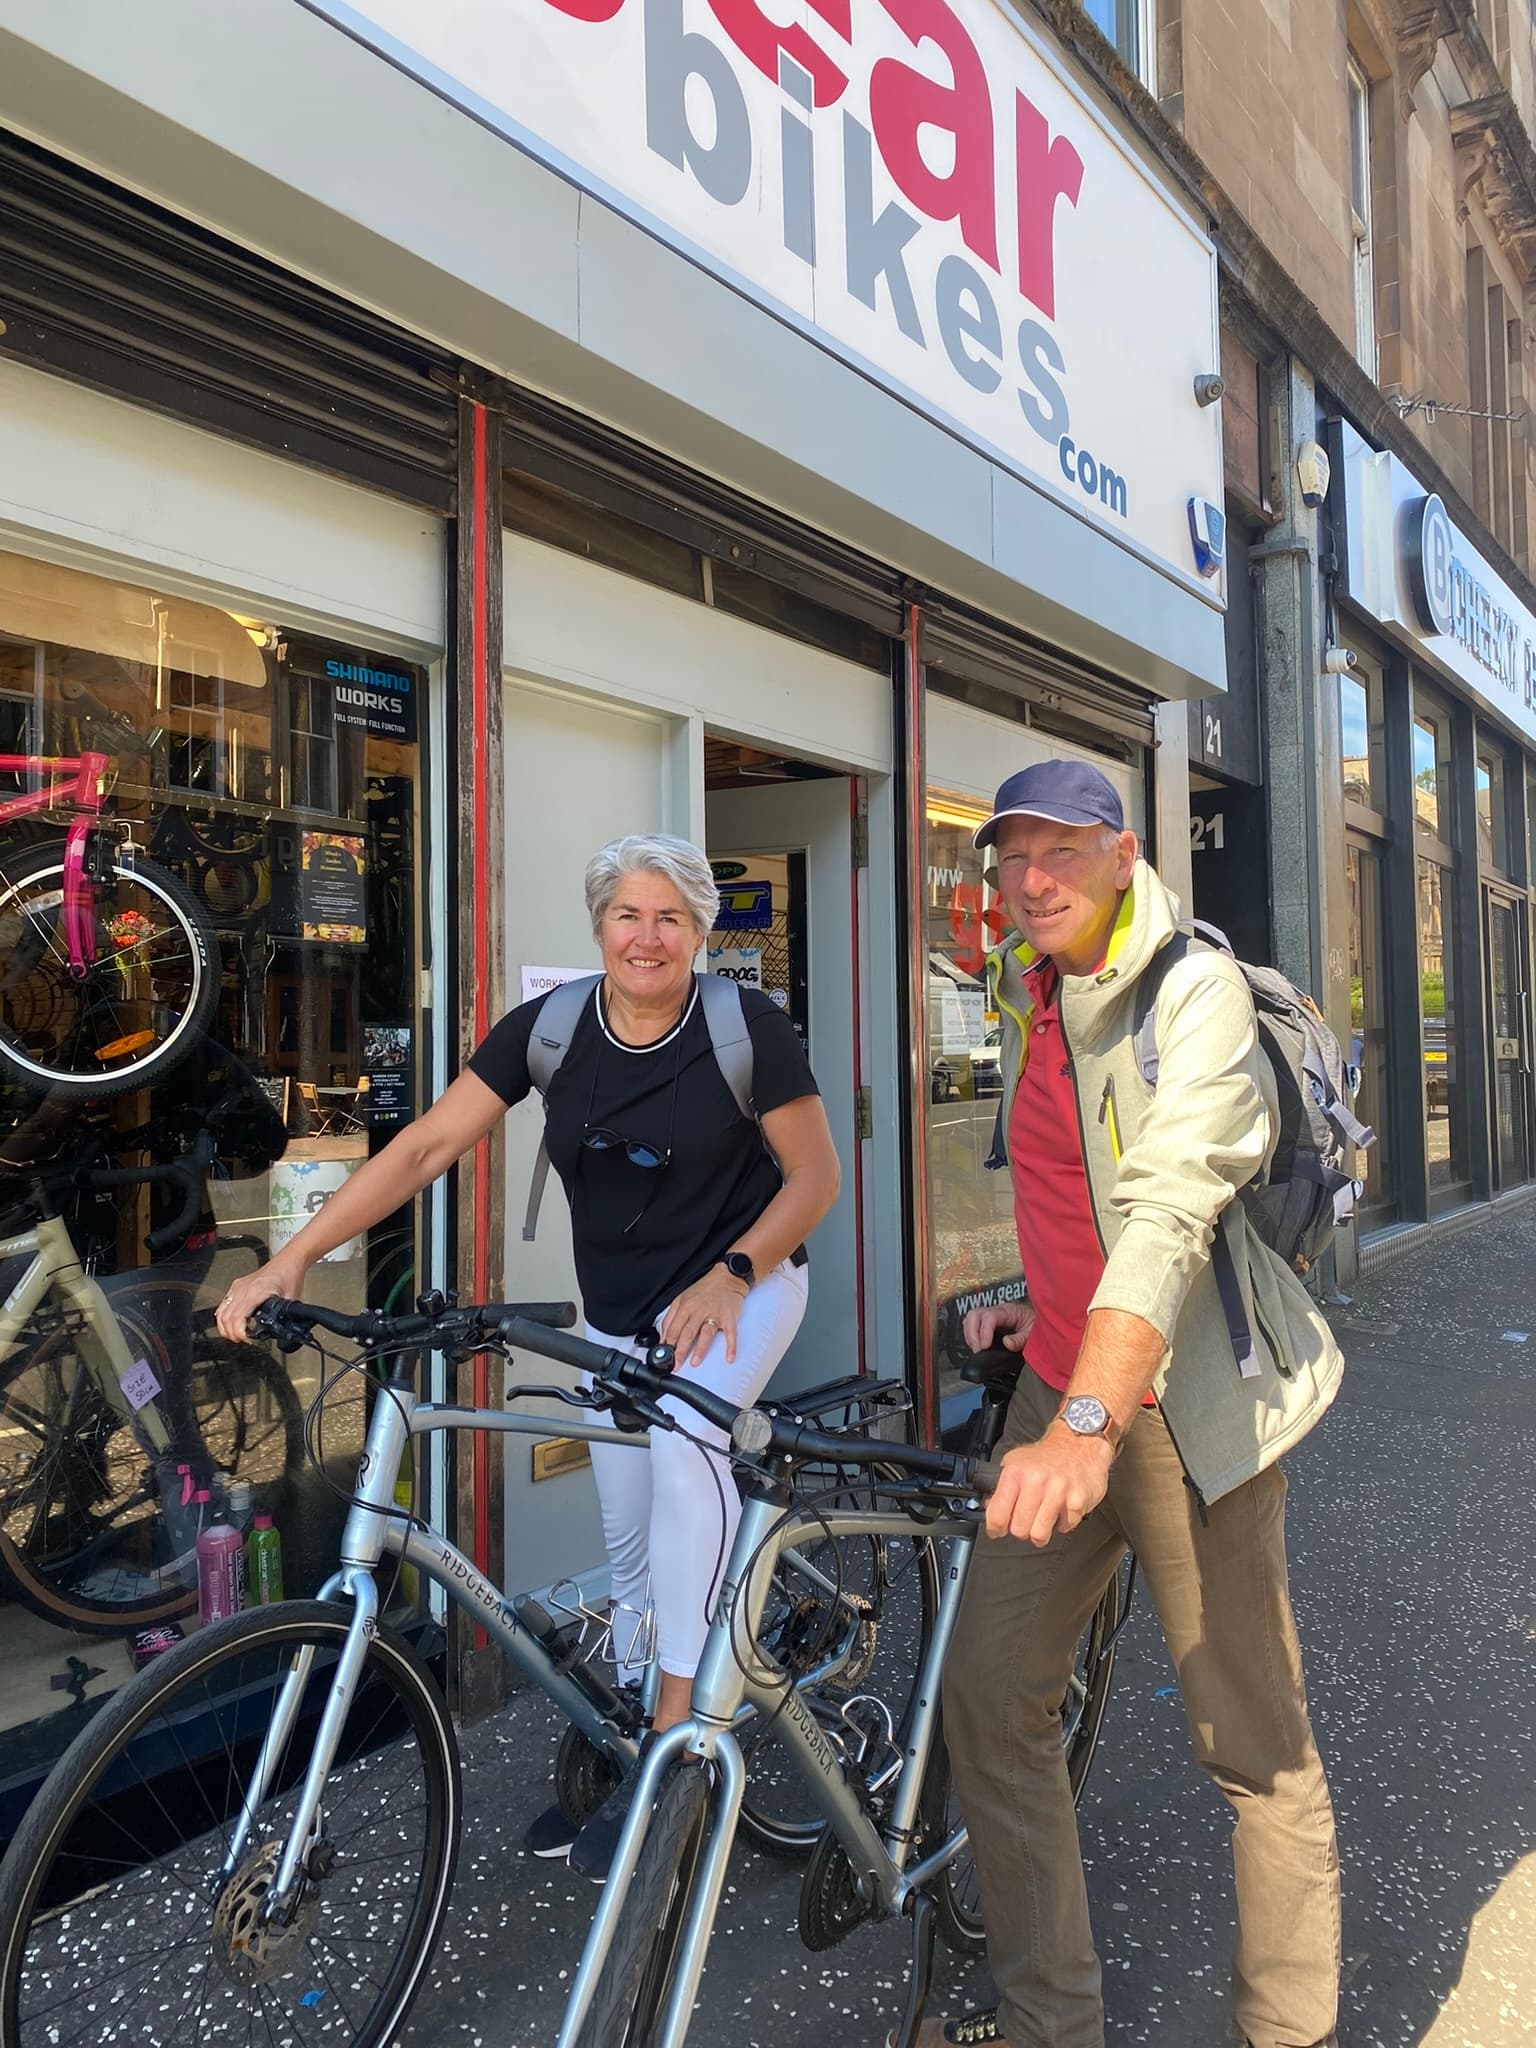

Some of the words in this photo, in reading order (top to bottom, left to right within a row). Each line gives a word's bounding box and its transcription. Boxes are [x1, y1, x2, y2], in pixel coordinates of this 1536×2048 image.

[543, 0, 1085, 322] ear
[643, 0, 1069, 446] bikes
[1060, 436, 1127, 519] com
[326, 660, 410, 692] SHIMANO
[333, 713, 346, 724] FULL
[368, 719, 381, 730] FULL
[336, 686, 402, 714] WORKS
[1206, 715, 1221, 757] 21
[1191, 814, 1224, 850] 21
[188, 918, 207, 967] KENDA
[440, 1549, 520, 1635] RIDGEBACK
